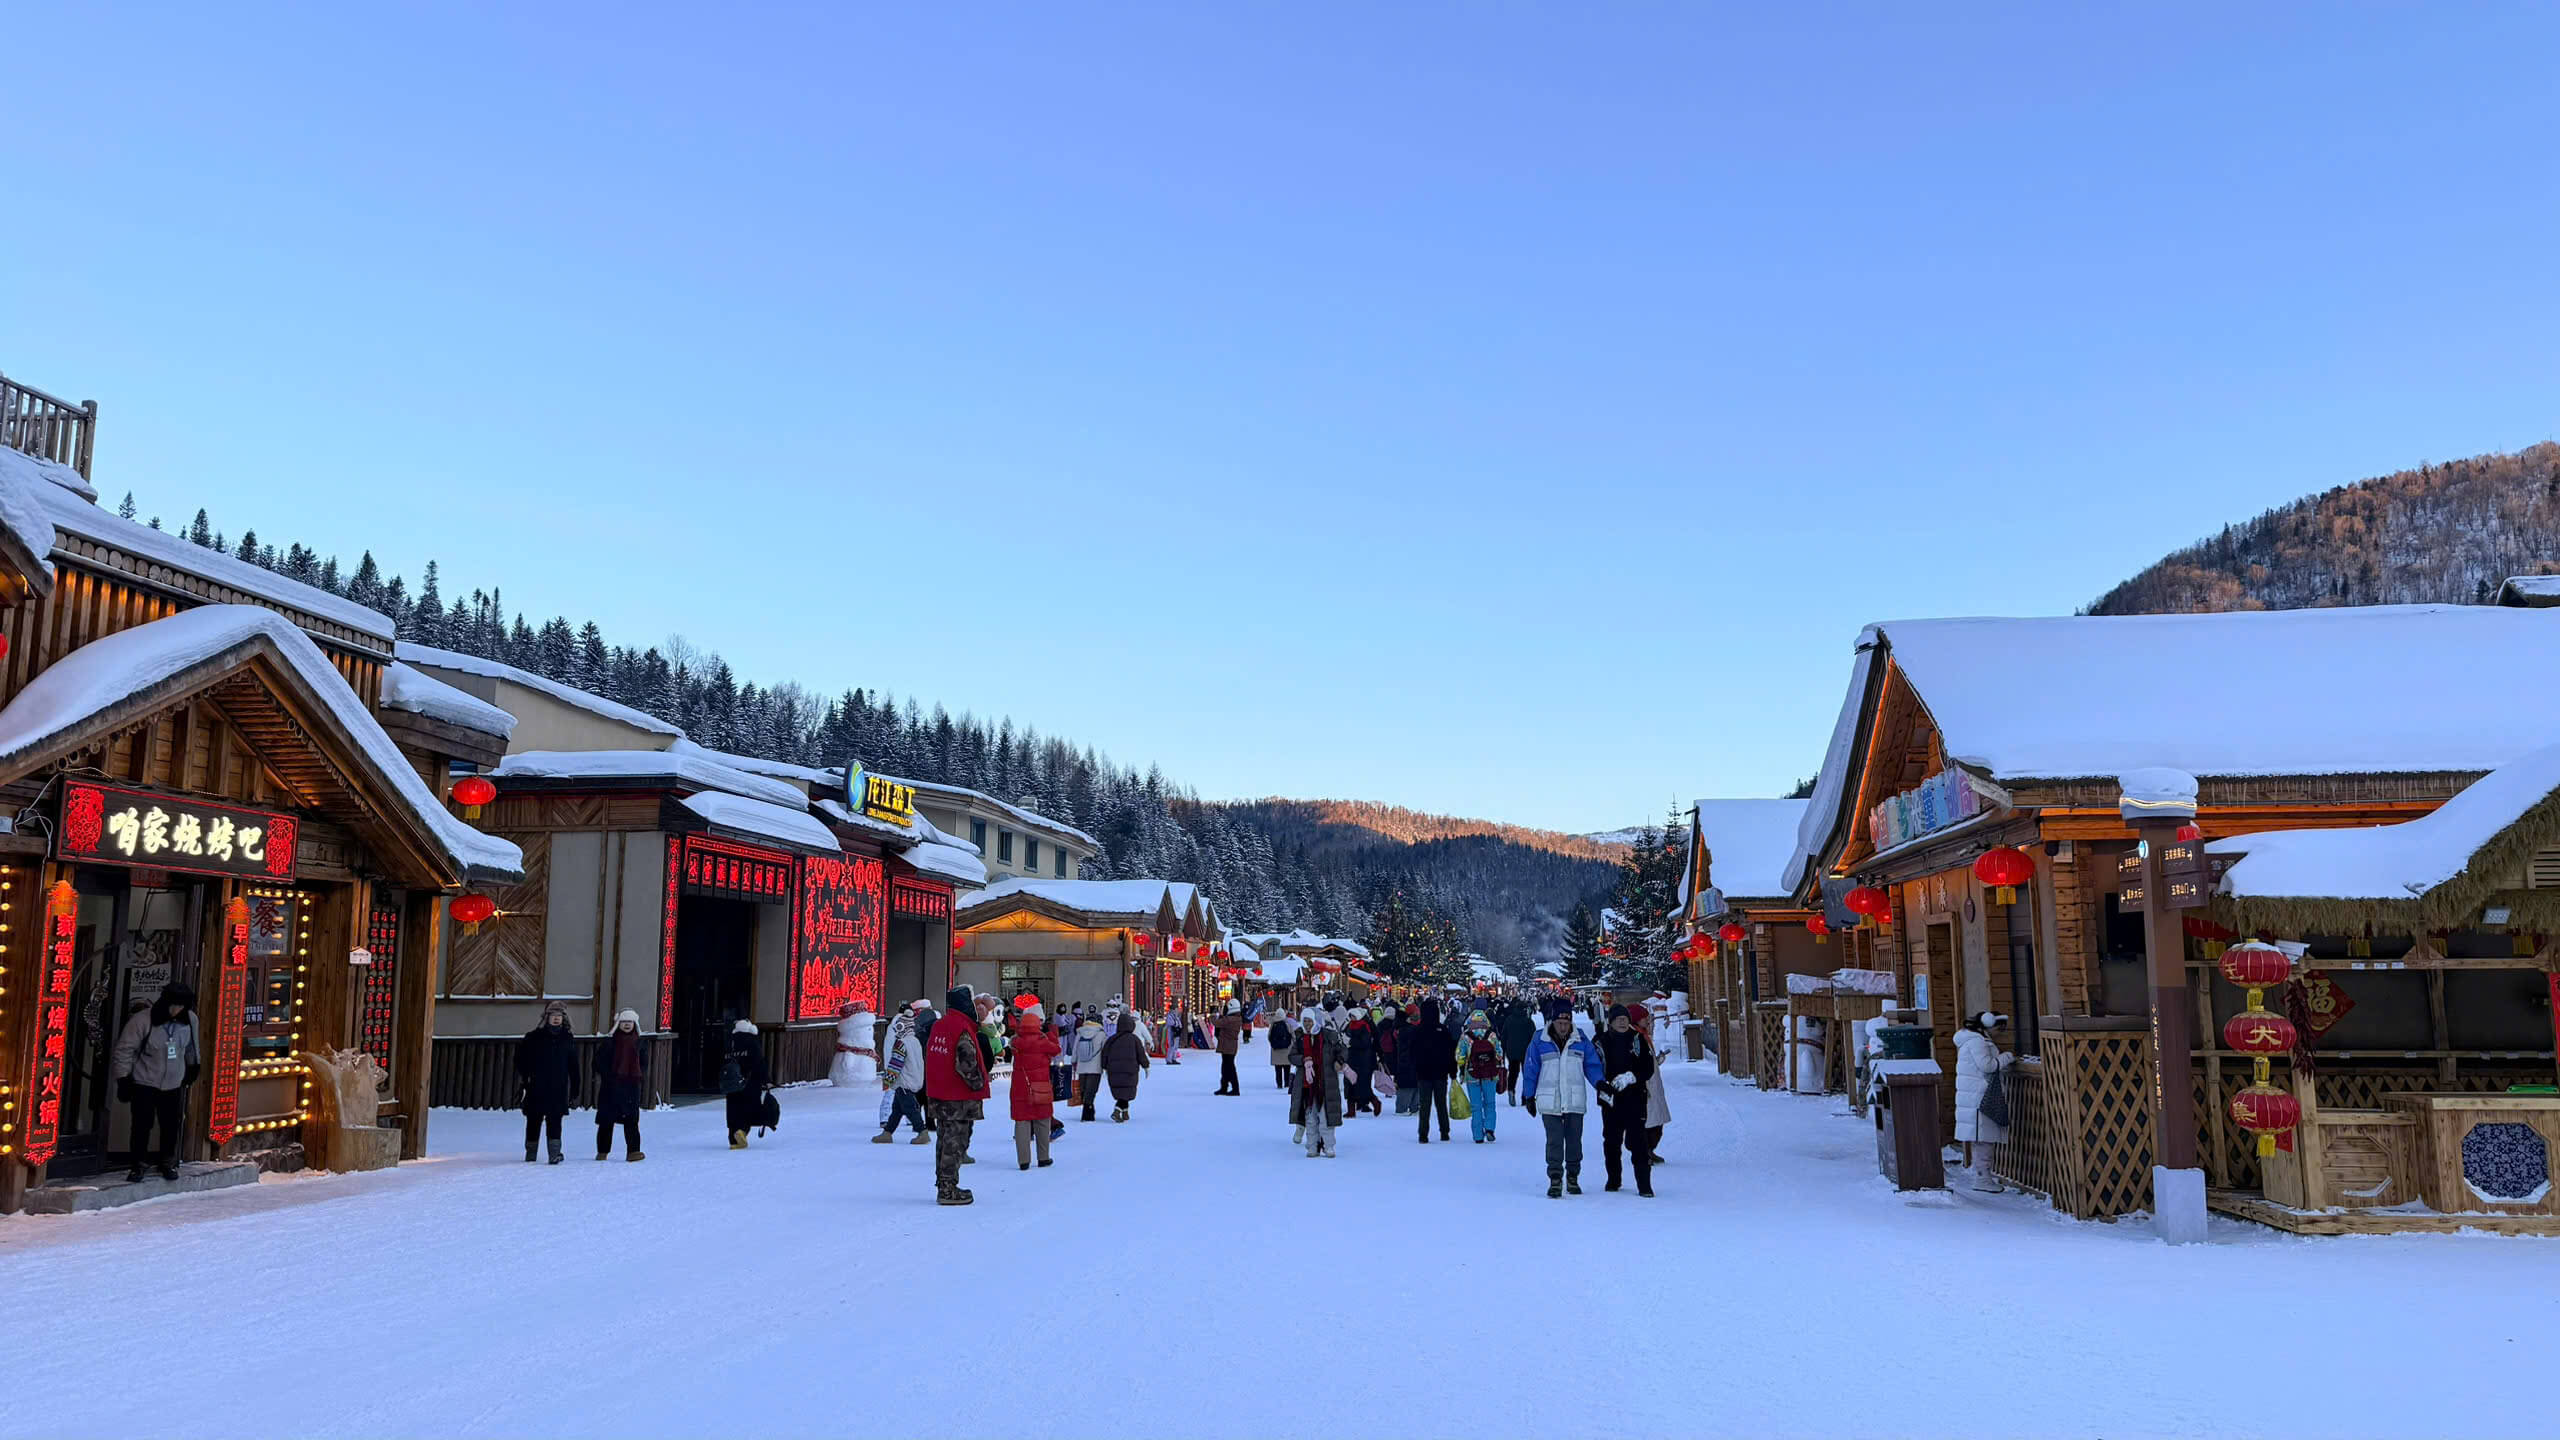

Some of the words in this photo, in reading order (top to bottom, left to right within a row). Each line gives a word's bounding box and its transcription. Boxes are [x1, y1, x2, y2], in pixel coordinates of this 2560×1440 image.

[868, 776, 915, 815] 龙江森工
[108, 806, 264, 861] 咱家烧烤吧
[232, 924, 248, 964] 早餐
[2303, 978, 2337, 1014] 福
[2246, 1026, 2282, 1045] 大
